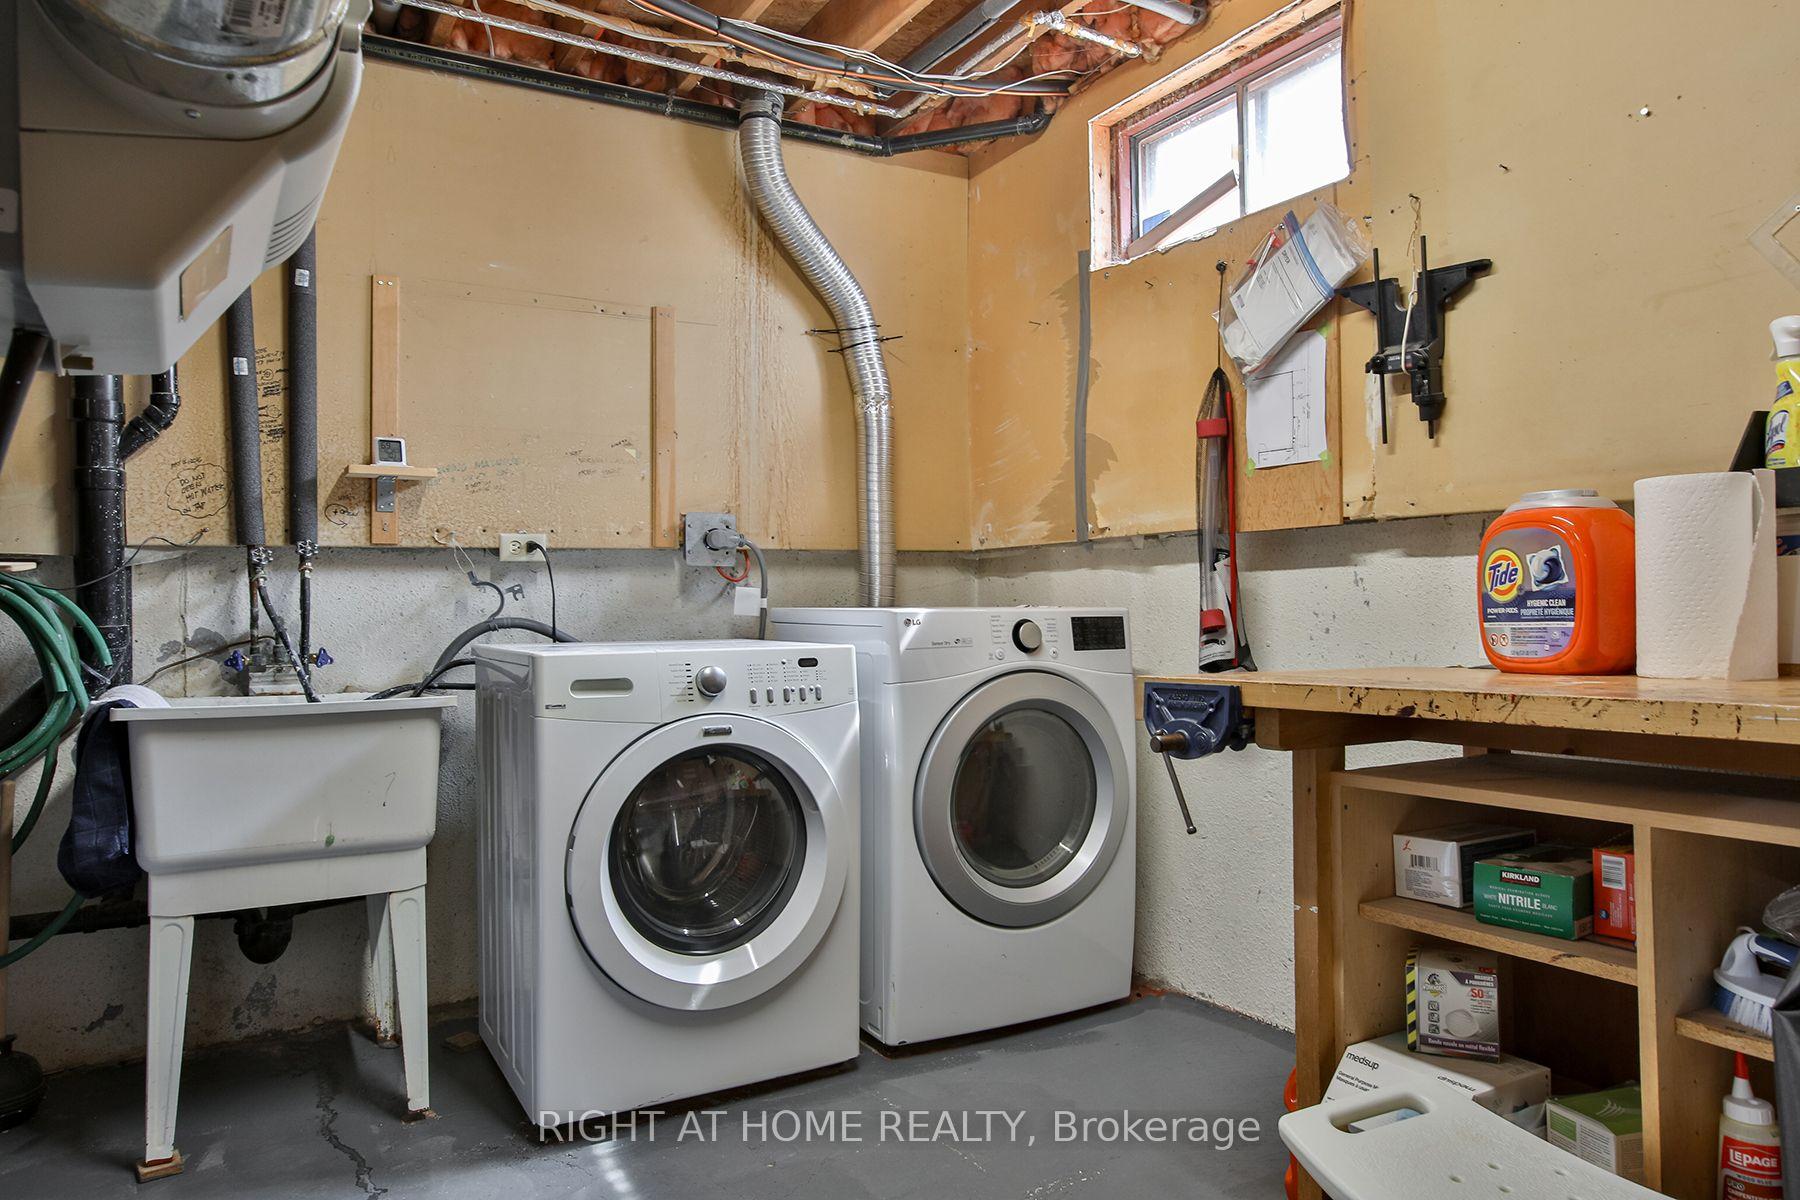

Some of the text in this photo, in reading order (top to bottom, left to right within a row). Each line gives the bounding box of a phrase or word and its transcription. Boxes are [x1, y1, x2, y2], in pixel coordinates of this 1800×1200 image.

[1488, 561, 1519, 593] Tide
[1526, 599, 1567, 607] HYGIENIC CLEAN
[912, 618, 922, 626] LG
[1501, 871, 1540, 883] KIRKLAND
[1498, 892, 1541, 910] NITRILE
[1542, 903, 1559, 911] BLANC
[1345, 1051, 1380, 1071] medsup
